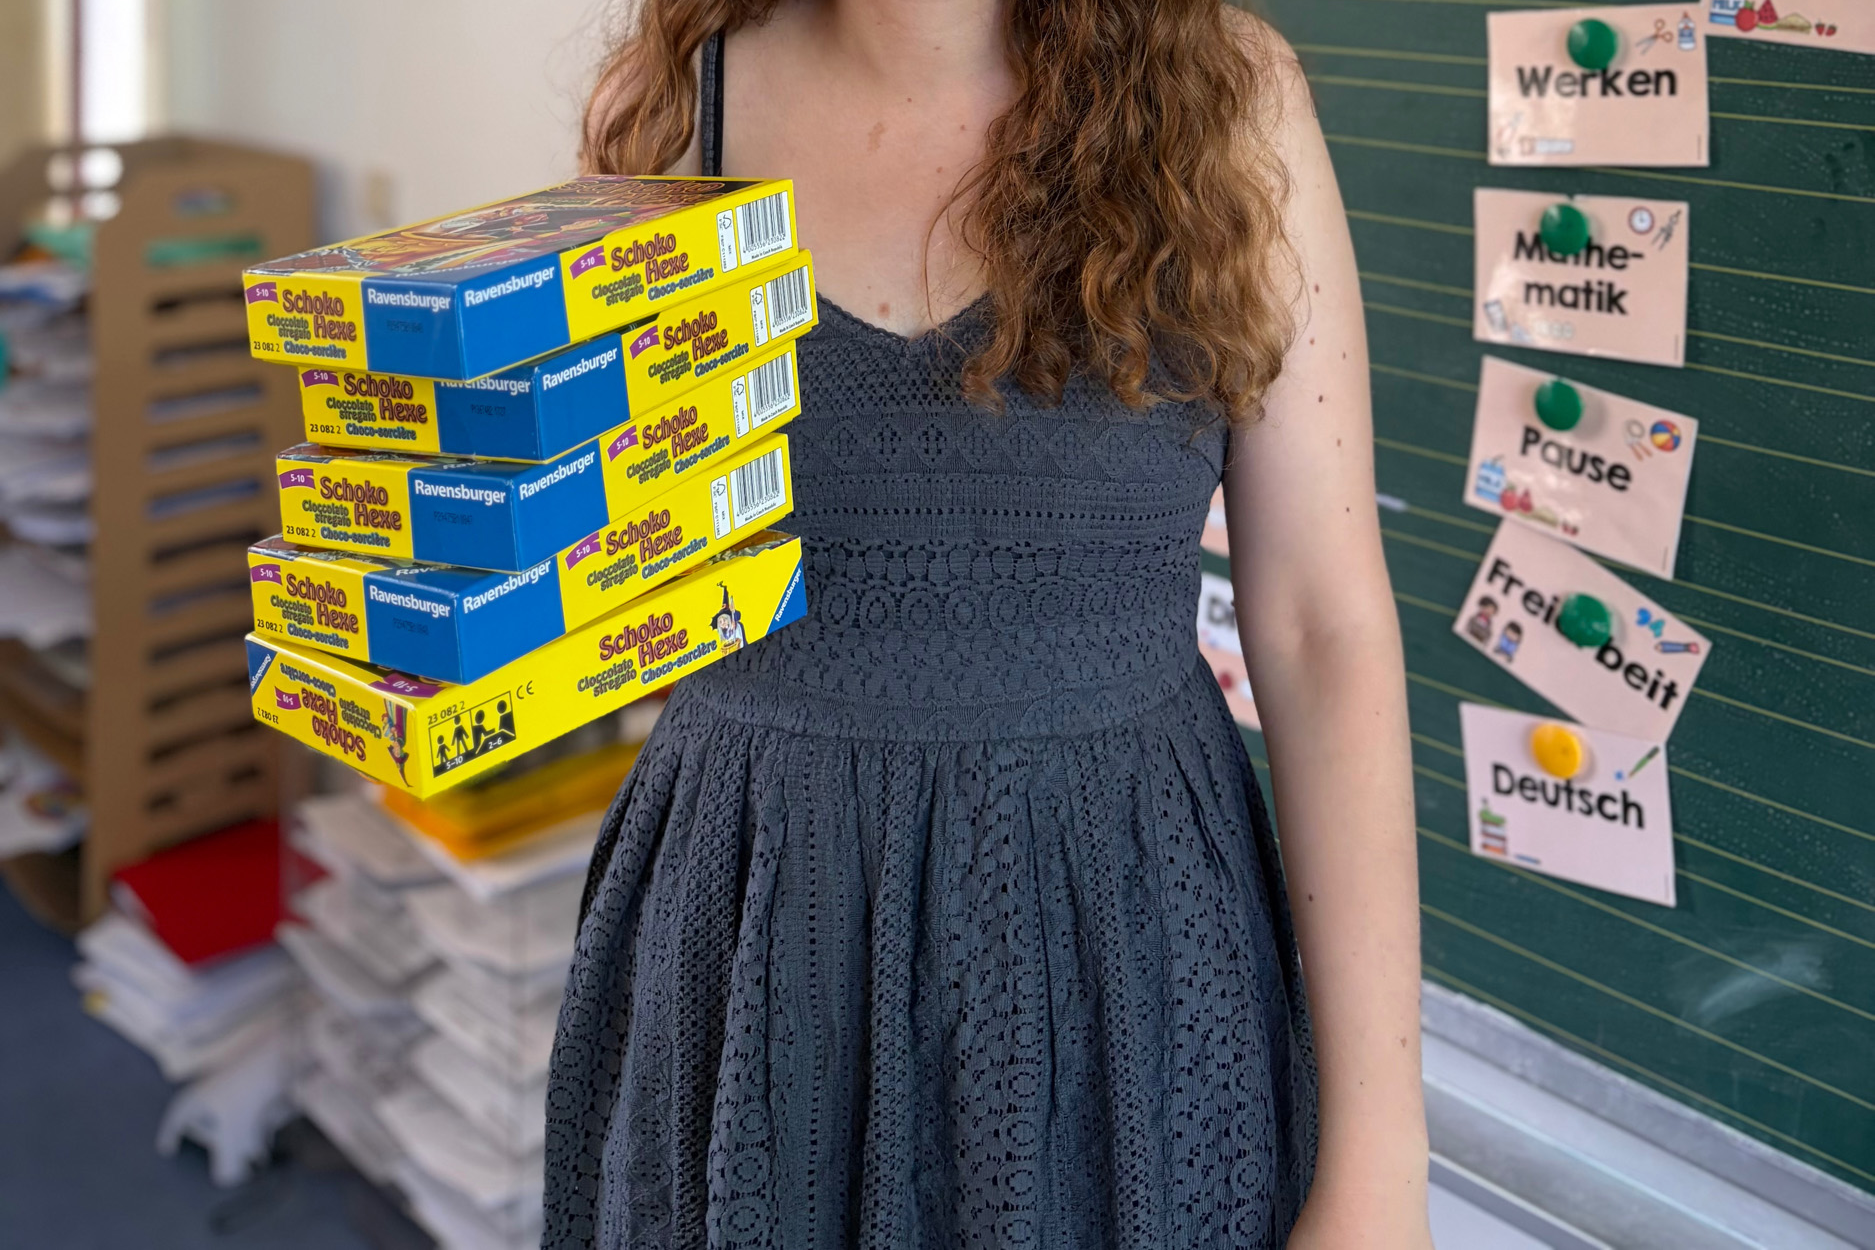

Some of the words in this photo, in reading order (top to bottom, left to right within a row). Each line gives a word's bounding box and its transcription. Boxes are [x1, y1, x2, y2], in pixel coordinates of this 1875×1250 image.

[1516, 64, 1678, 97] Werken
[580, 256, 596, 269] 5-10
[610, 232, 677, 272] Schoko
[645, 252, 690, 286] Hexe
[256, 288, 269, 298] 5-10
[282, 289, 345, 317] Schoko
[367, 288, 451, 312] Ravensburger
[464, 266, 556, 308] Ravensburger
[1524, 280, 1628, 315] matik
[313, 314, 358, 342] Hexe
[638, 336, 651, 348] 5-10
[664, 310, 718, 350] Schoko
[253, 340, 262, 350] 23
[262, 342, 274, 352] 082
[276, 343, 280, 352] 2
[692, 328, 729, 362] Hexe
[313, 371, 329, 382] 5-10
[542, 346, 618, 391] Ravensburger
[343, 372, 414, 400] Schoko
[379, 398, 428, 424] Hexe
[642, 404, 698, 450] Schoko
[310, 424, 318, 433] 23
[320, 424, 334, 434] 082
[336, 425, 341, 434] 2
[616, 437, 630, 450] 5-10
[672, 422, 709, 460] Hexe
[1520, 424, 1632, 492] Pause
[290, 474, 305, 484] 5-10
[320, 476, 389, 506] Schoko
[518, 450, 596, 501] Ravensburger
[414, 479, 507, 506] Ravensburger
[286, 526, 294, 536] 23
[296, 527, 310, 538] 082
[311, 528, 316, 538] 2
[354, 502, 402, 532] Hexe
[605, 508, 671, 557] Schoko
[575, 544, 591, 558] 5-10
[640, 524, 684, 565] Hexe
[260, 568, 273, 578] 5-10
[462, 559, 552, 615] Ravensburger
[286, 573, 347, 608] Schoko
[368, 584, 451, 618] Ravensburger
[774, 567, 802, 622] Ravensburger
[256, 618, 264, 628] 23
[266, 620, 278, 632] 082
[279, 624, 284, 634] 2
[316, 602, 360, 634] Hexe
[1486, 557, 1680, 711] Freibeit
[599, 612, 674, 661] Schoko
[638, 628, 689, 668] Hexe
[392, 680, 418, 693] 5-10
[577, 658, 634, 693] Cioccolato
[592, 668, 638, 698] stregato
[300, 688, 338, 726] Hexe
[428, 714, 438, 725] 23
[440, 706, 458, 720] 082
[460, 700, 466, 710] 2
[312, 715, 366, 762] Schoko
[1491, 762, 1645, 830] Deutsch
